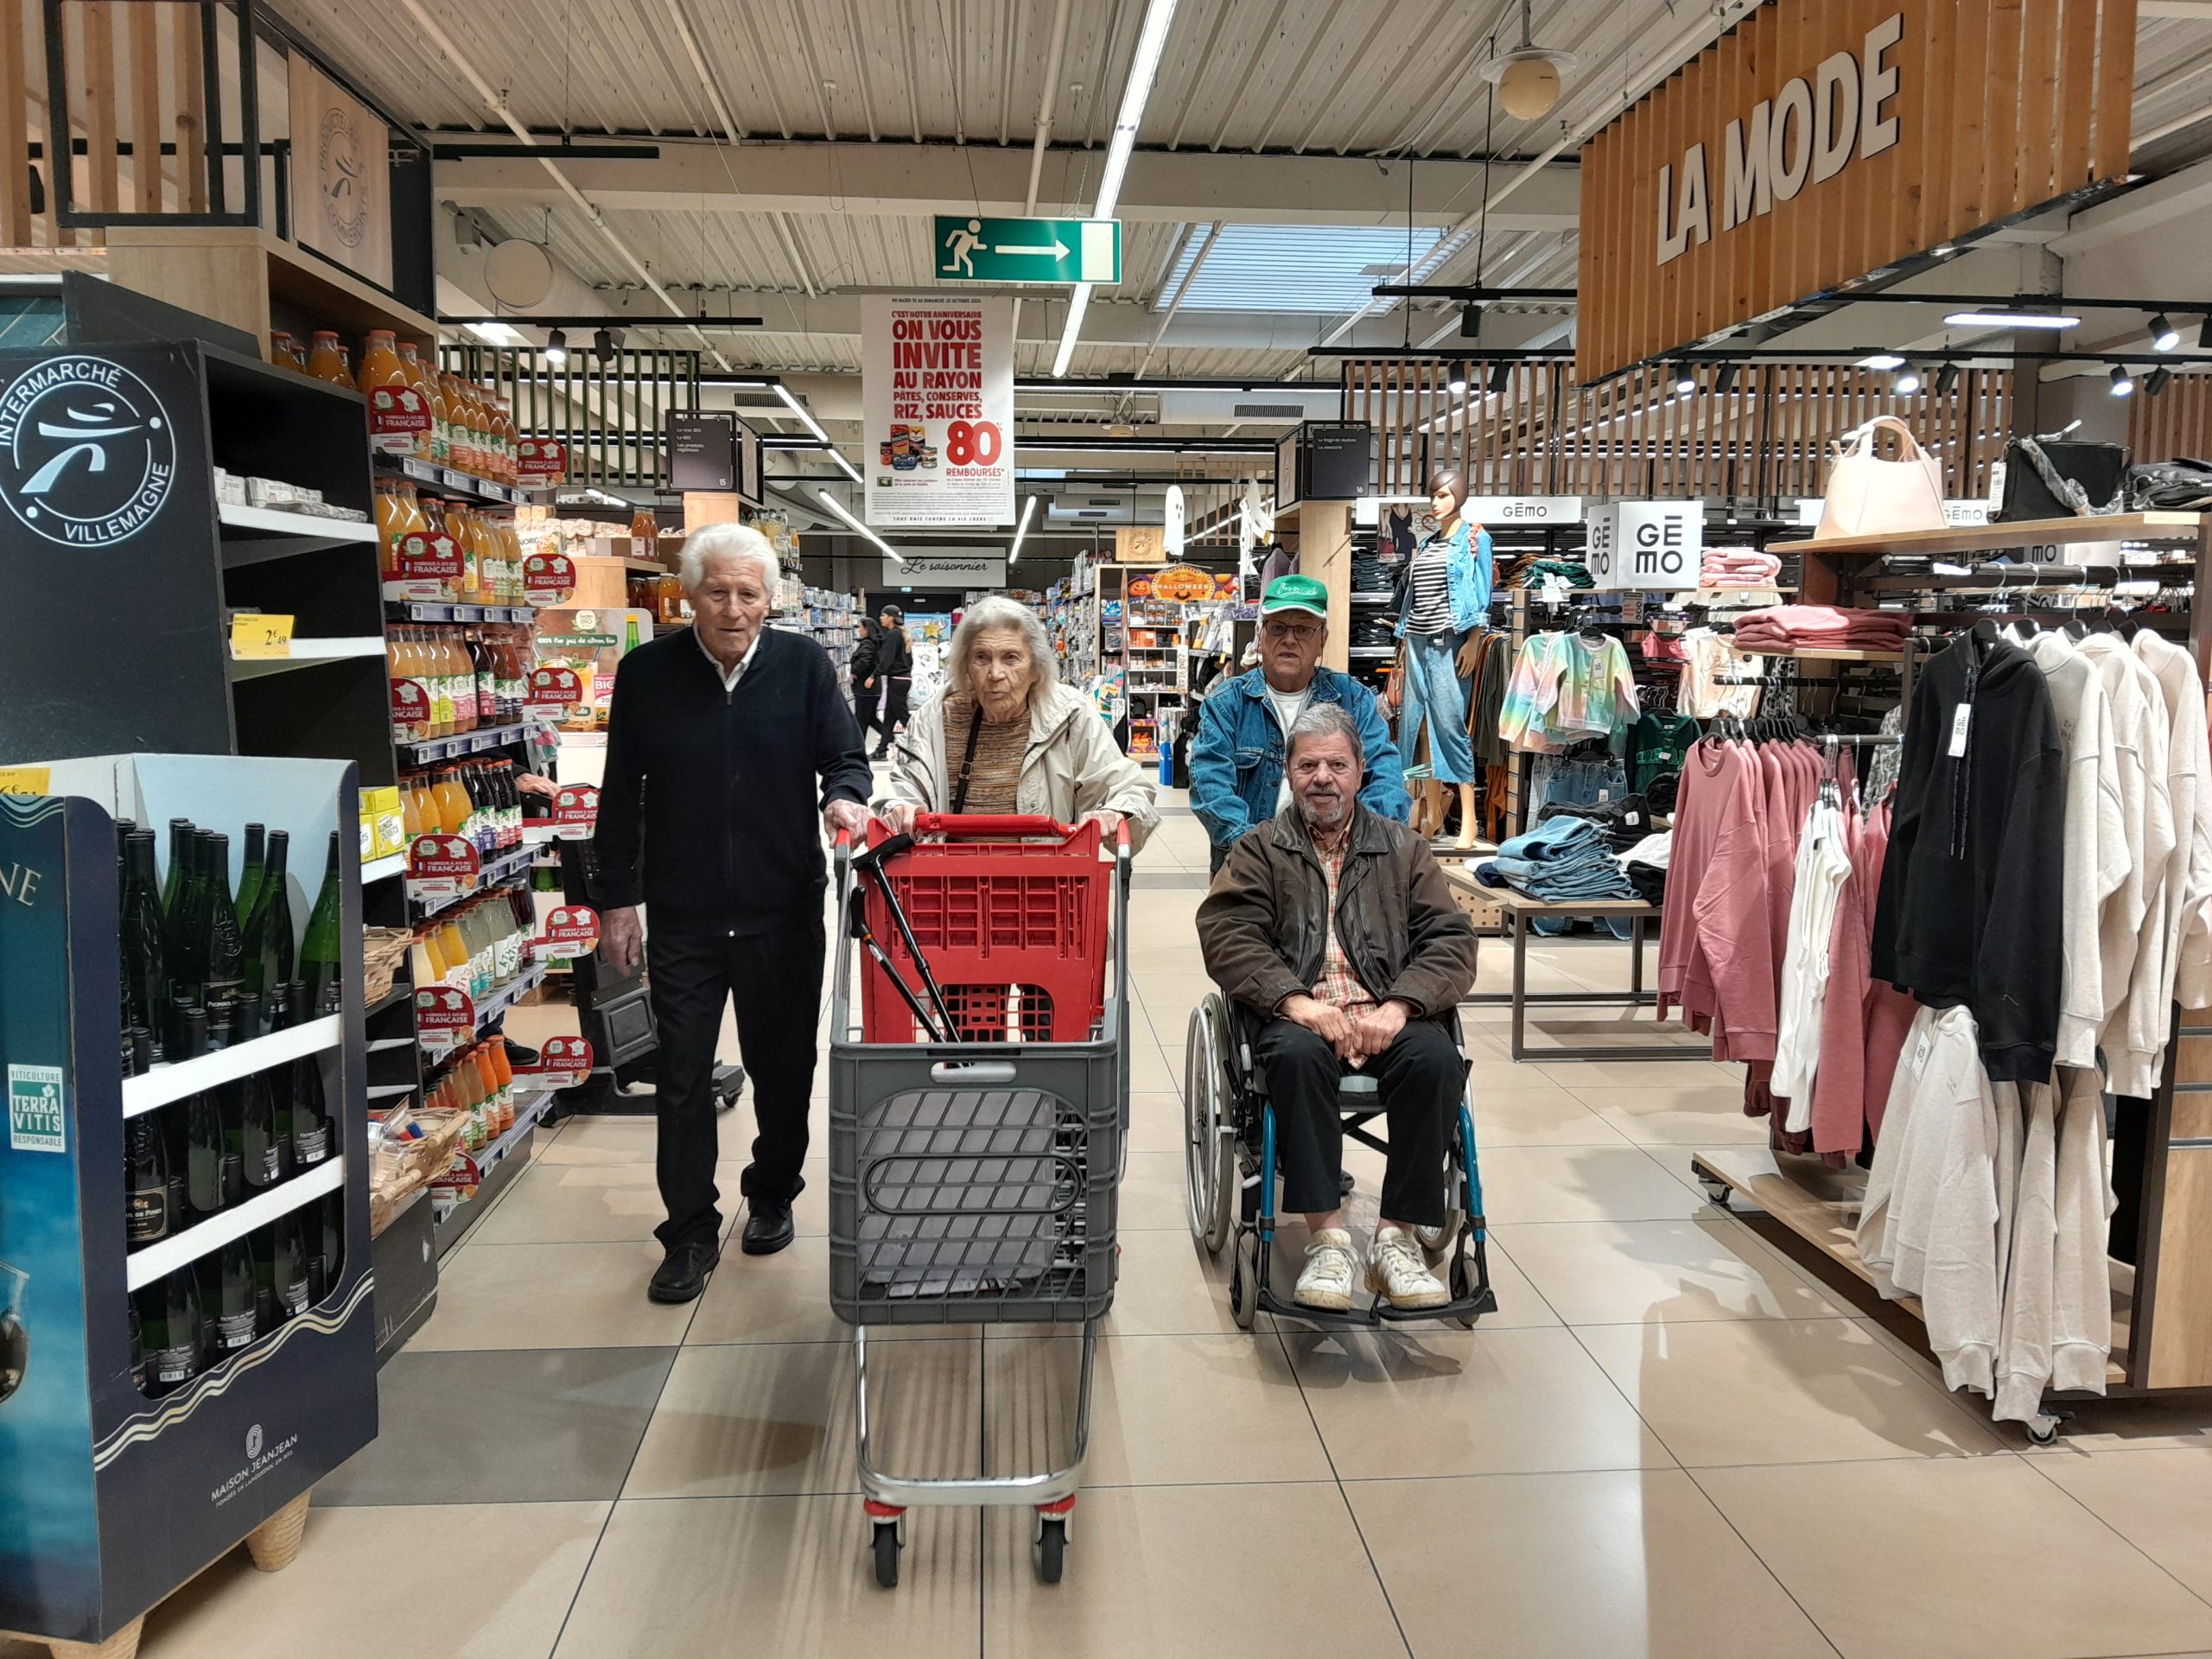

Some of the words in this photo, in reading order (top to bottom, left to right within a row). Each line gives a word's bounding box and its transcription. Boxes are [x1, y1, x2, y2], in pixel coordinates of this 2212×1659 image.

[1657, 143, 1711, 266] LA
[1724, 13, 1903, 232] MODE
[893, 320, 923, 340] ON
[928, 320, 982, 340] VOUS
[893, 342, 982, 369] INVITE
[893, 372, 918, 389] AU
[923, 372, 982, 389] RAYON
[0, 362, 122, 447] INTERMARCHÉ
[893, 391, 925, 403] PÂTES,
[926, 391, 982, 403] CONSERVES,
[893, 404, 923, 423] RIZ,
[925, 404, 982, 419] SAUCES
[64, 462, 168, 541] VILLEMAGNE
[900, 556, 926, 575] Le
[929, 562, 988, 571] saisonnier
[1635, 550, 1683, 574] MO
[11, 1071, 60, 1082] VITICULTURE
[13, 1096, 59, 1114] TERRA
[14, 1113, 60, 1132] VITIS
[14, 1135, 61, 1147] RESPONSABLE
[211, 1467, 248, 1502] MAISON
[251, 1433, 297, 1472] JEANJEAN
